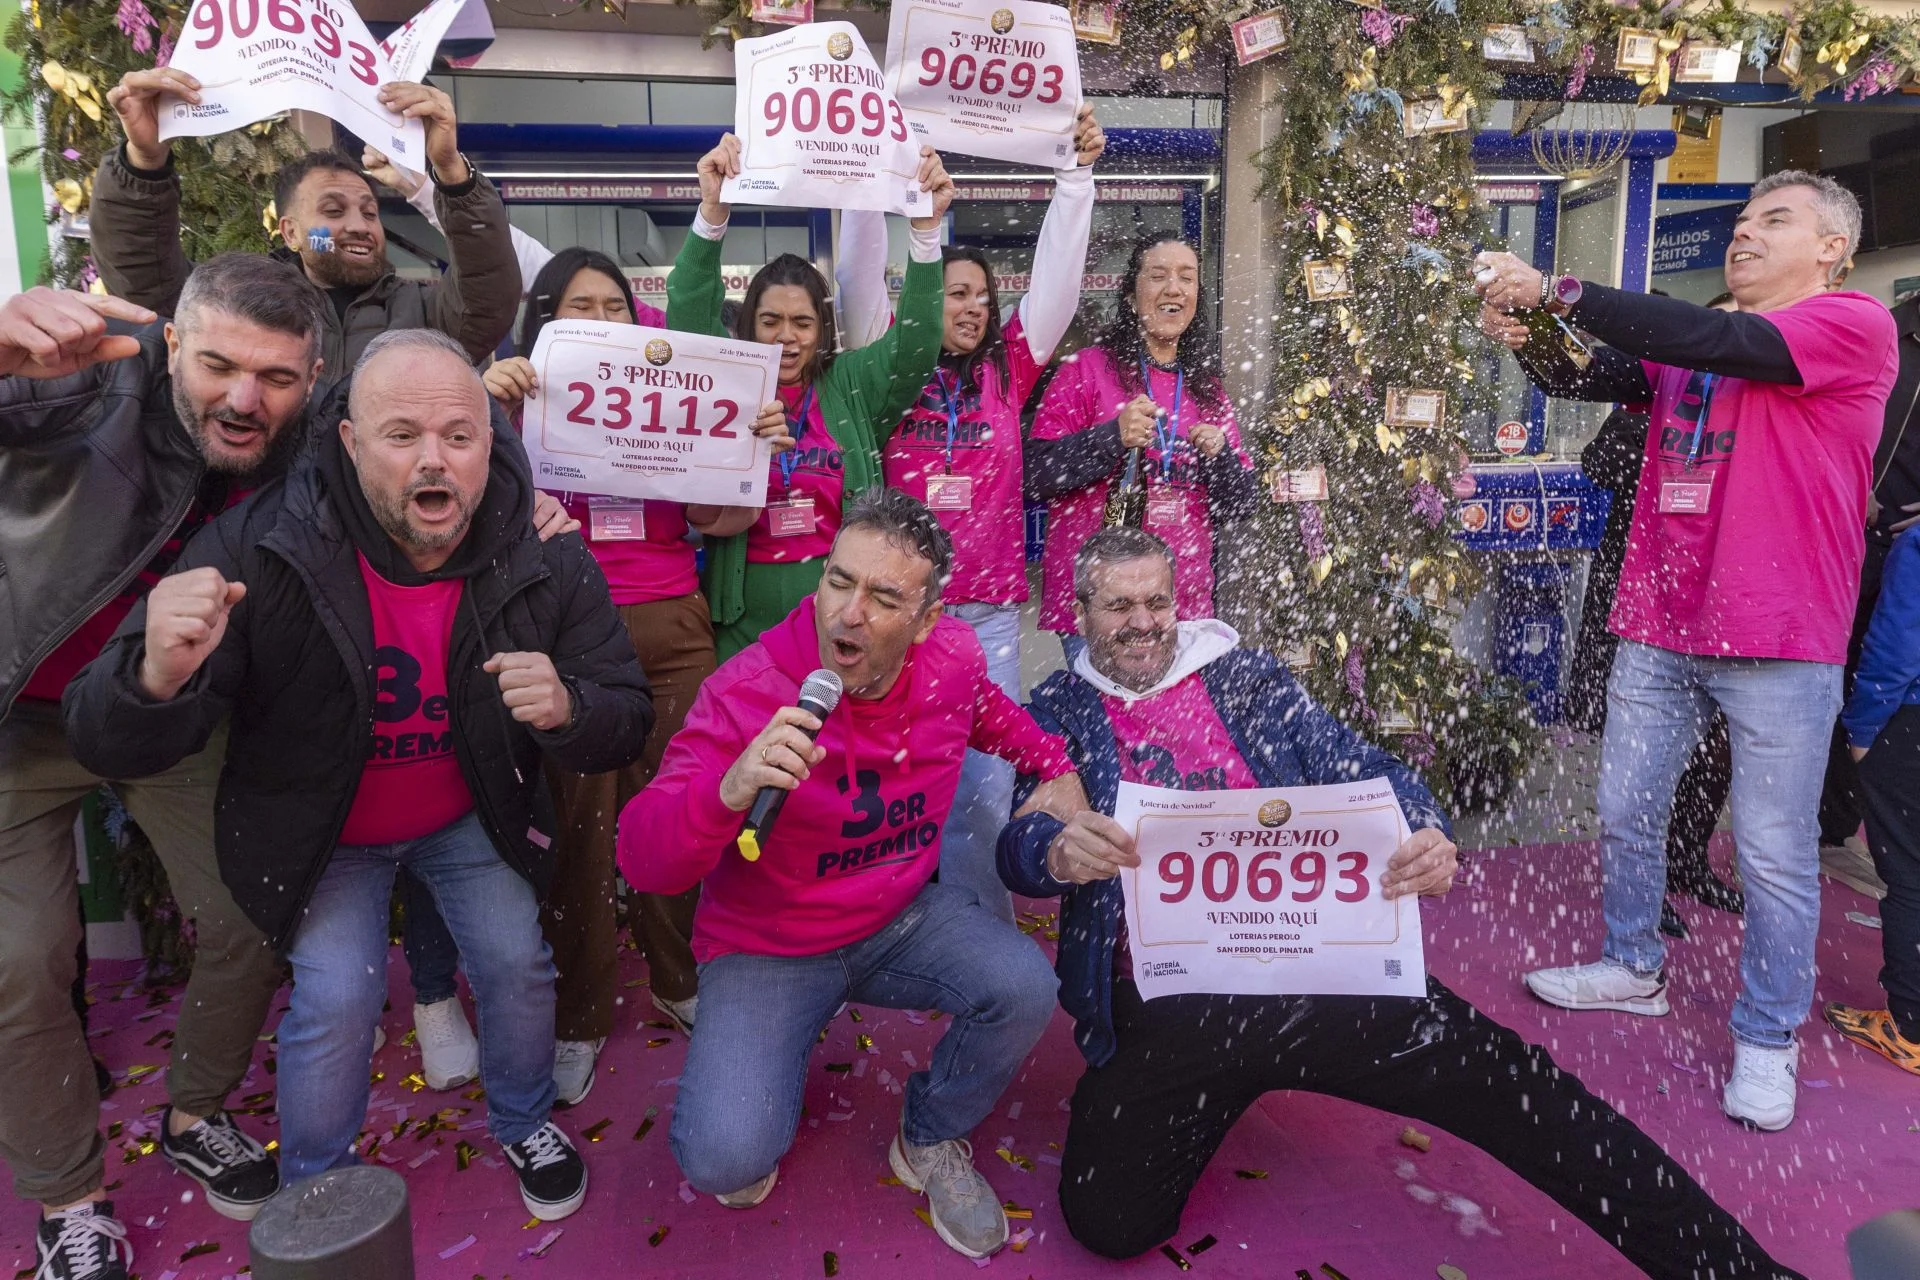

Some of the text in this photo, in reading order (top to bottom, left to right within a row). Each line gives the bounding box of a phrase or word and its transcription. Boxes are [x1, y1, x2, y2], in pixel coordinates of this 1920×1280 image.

[971, 34, 1046, 59] PREMIO
[238, 38, 337, 74] VENDIDO AQUÍ
[289, 57, 322, 74] PEROLO
[249, 76, 262, 86] SAN
[262, 69, 283, 81] PEDRO
[300, 71, 334, 90] PINATAR
[809, 64, 885, 90] PREMIO
[918, 47, 1064, 104] 90693
[948, 94, 994, 109] VENDIDO
[192, 108, 230, 118] NACIONAL
[764, 87, 908, 142] 90693
[986, 114, 1007, 122] PEROLO
[991, 124, 1013, 133] PINATAR
[796, 140, 880, 156] VENDIDO AQUÍ
[667, 186, 700, 198] LOTE
[1653, 245, 1700, 261] CRITOS
[624, 365, 713, 392] PREMIO
[566, 382, 739, 439] 23112
[605, 435, 693, 452] VENDIDO AQUÍ
[555, 465, 580, 473] LOTERÍA
[555, 471, 586, 479] NACIONAL
[376, 645, 448, 723] 3e
[374, 732, 454, 759] REM
[1229, 829, 1340, 848] PREMIO
[816, 822, 938, 878] PREMIO
[1158, 851, 1370, 904] 90693
[1207, 909, 1318, 927] VENDIDO AQUÍ
[1153, 961, 1180, 970] LOTERÍA
[1153, 967, 1188, 977] NACIONAL
